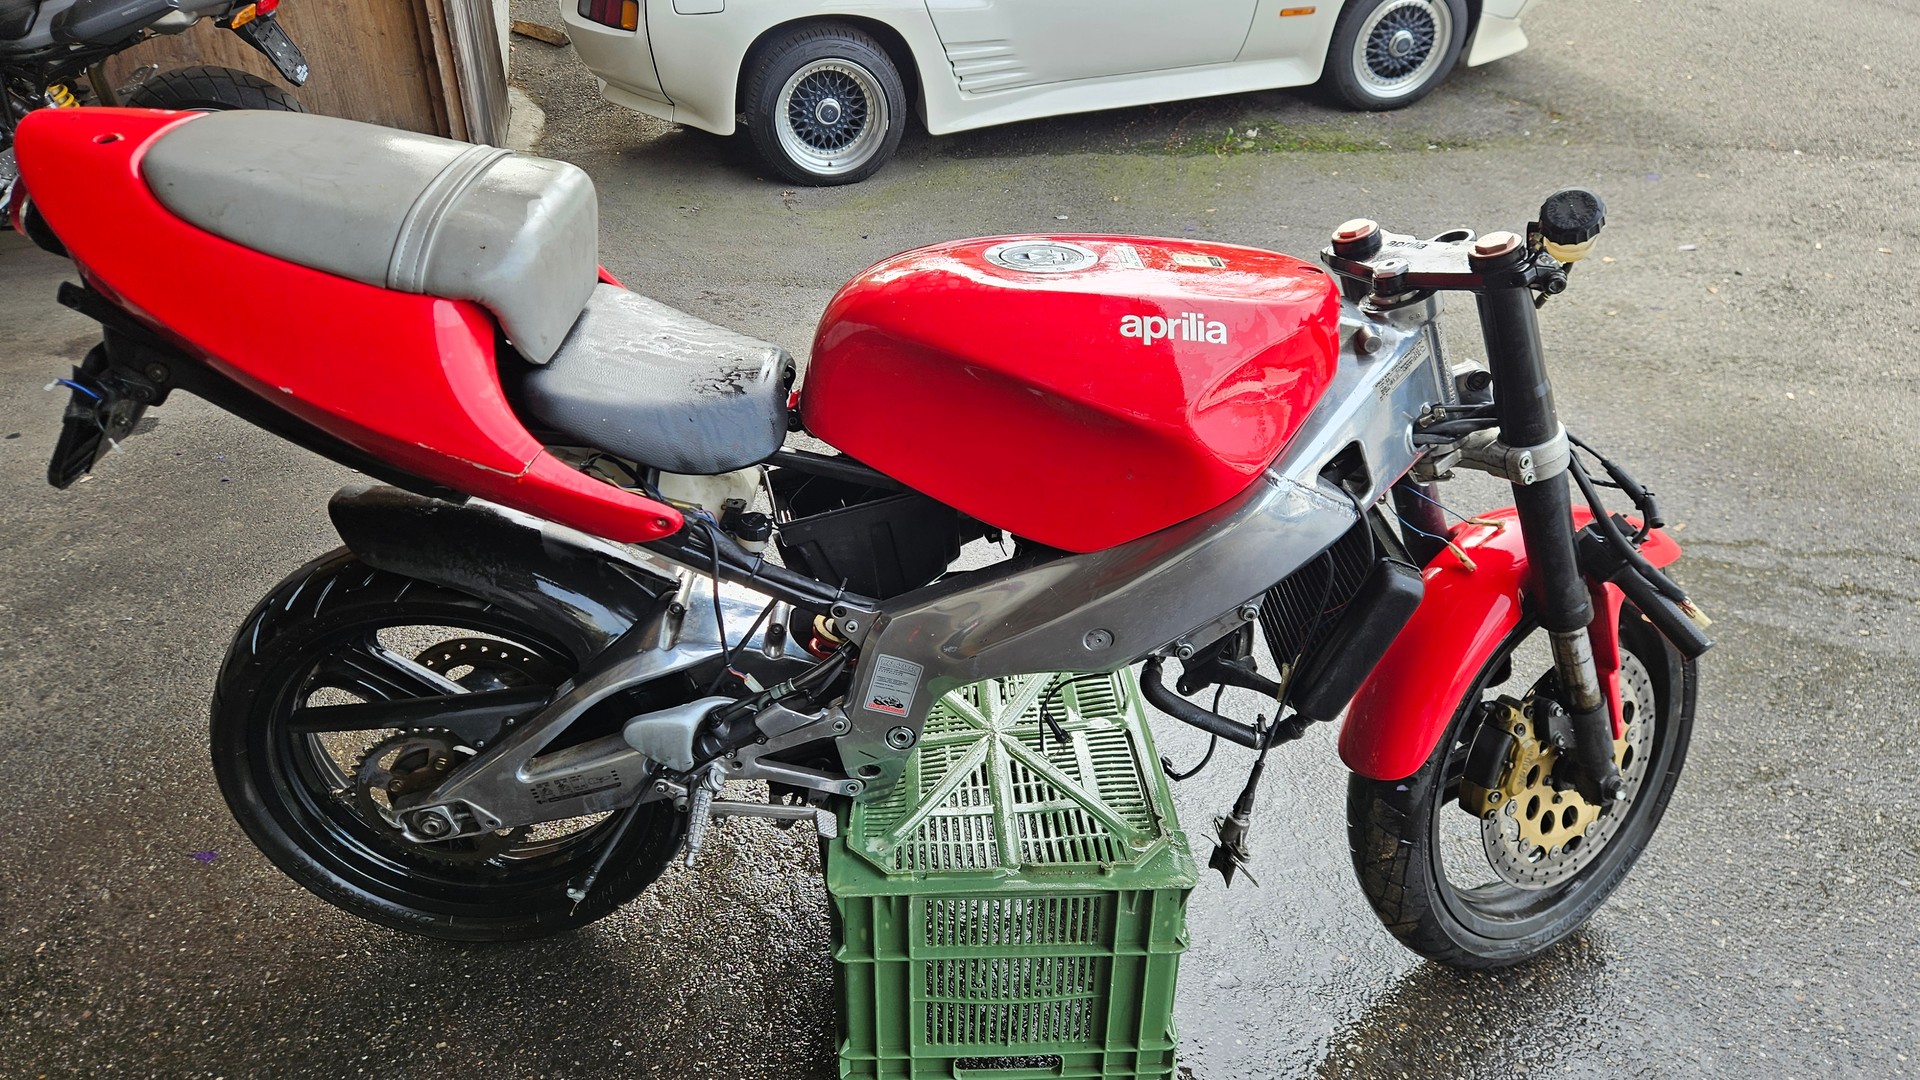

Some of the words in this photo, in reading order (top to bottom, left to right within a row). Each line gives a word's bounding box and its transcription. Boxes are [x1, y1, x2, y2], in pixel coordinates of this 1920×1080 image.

[1387, 240, 1428, 250] aprilia
[1119, 311, 1228, 346] aprilia
[293, 857, 436, 923] BRIDGESTE
